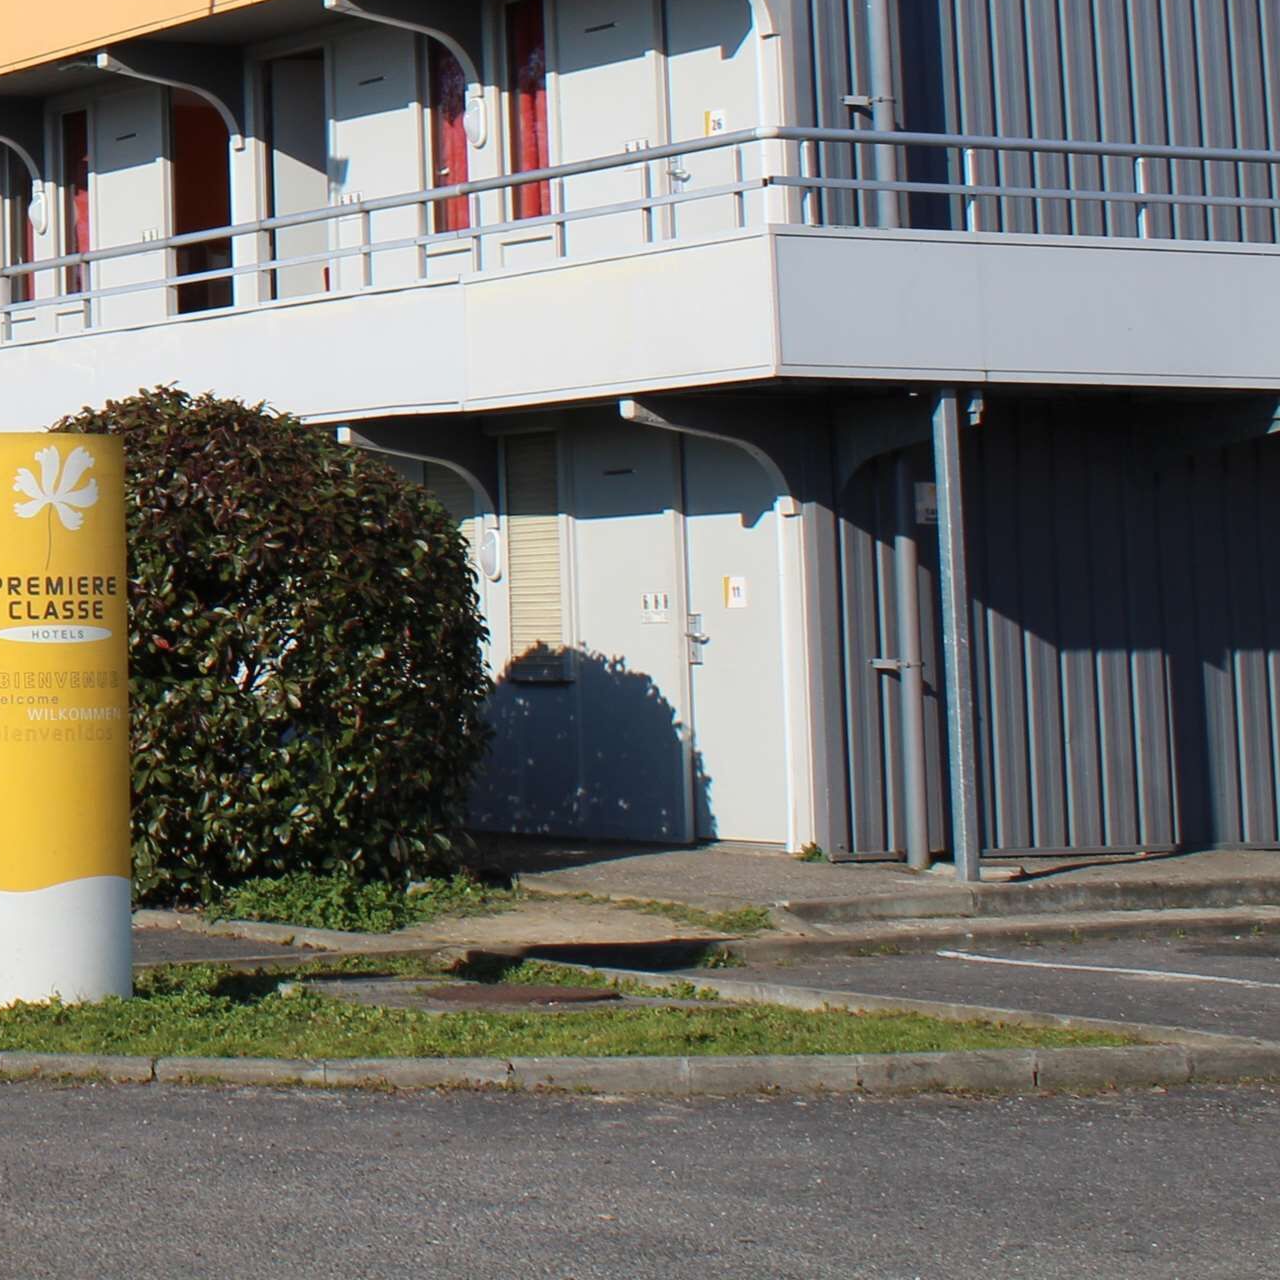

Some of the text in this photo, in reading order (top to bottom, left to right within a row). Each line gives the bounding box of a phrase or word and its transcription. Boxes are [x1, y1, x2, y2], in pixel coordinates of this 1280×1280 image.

[9, 600, 104, 620] CLASSE
[30, 629, 85, 640] HOTELS
[26, 707, 122, 721] WILKOMMEN
